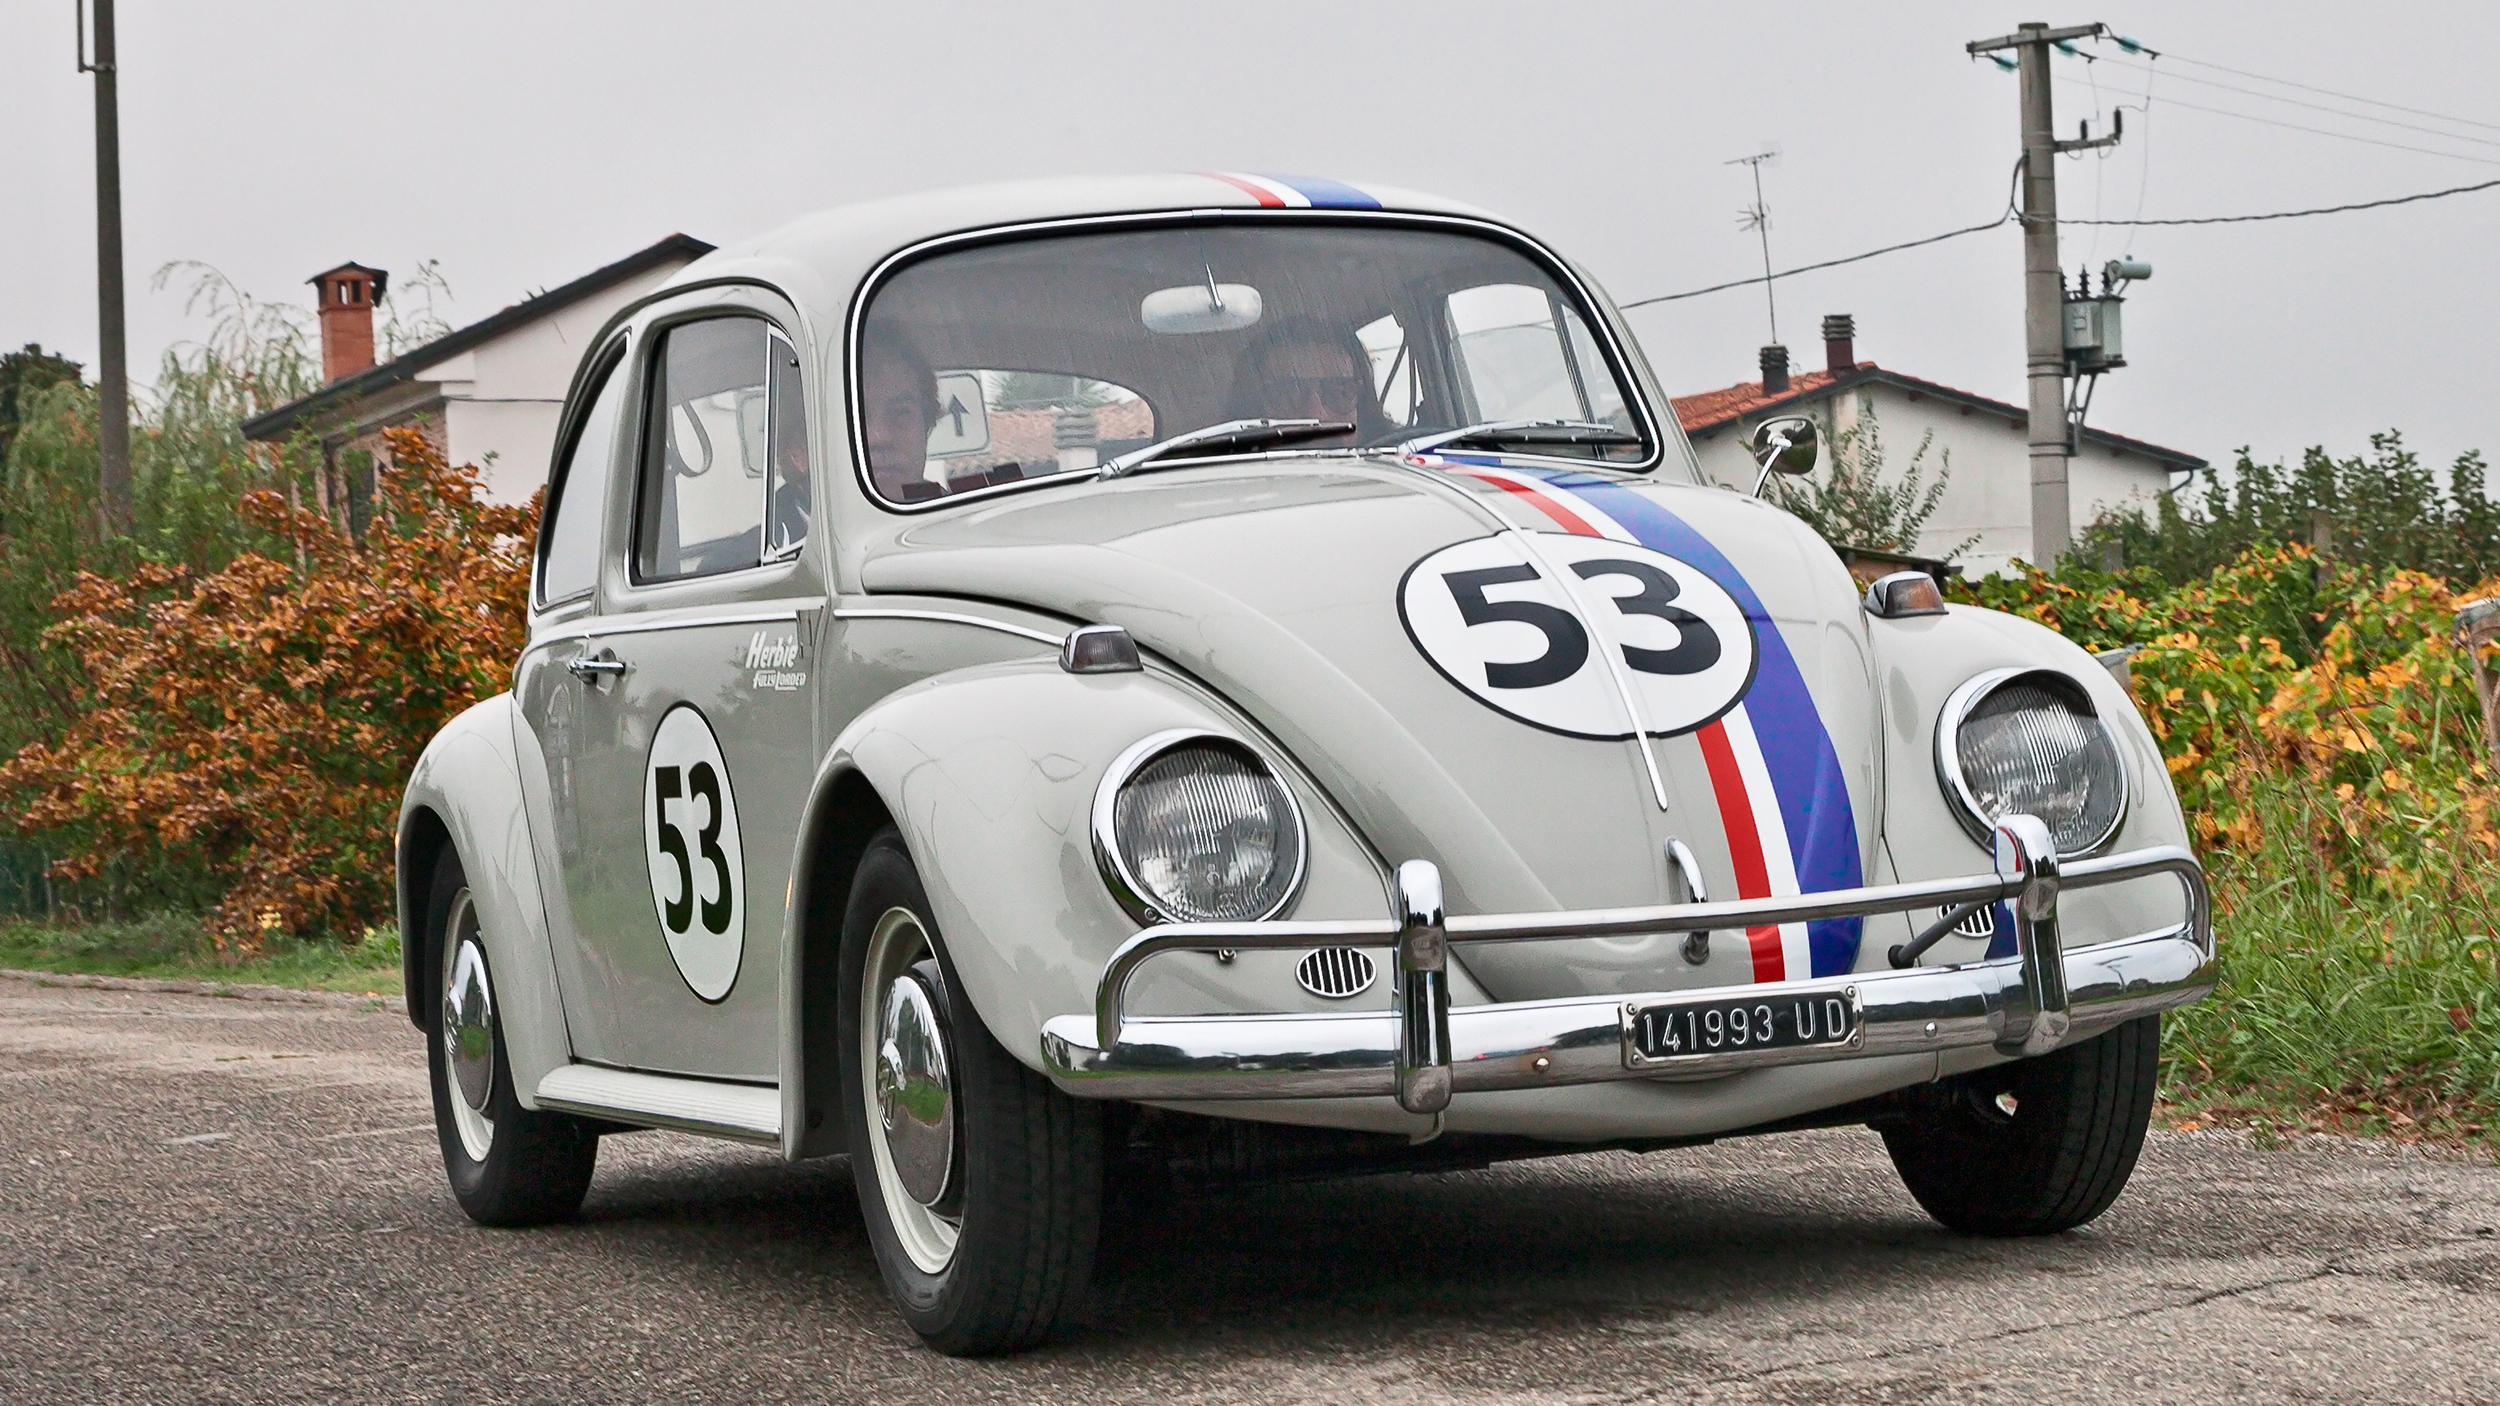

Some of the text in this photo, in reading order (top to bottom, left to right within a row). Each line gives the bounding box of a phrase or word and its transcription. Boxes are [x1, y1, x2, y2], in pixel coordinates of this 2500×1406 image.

[745, 630, 799, 669] Herbie
[1441, 558, 1722, 690] 53
[655, 761, 733, 935] 53
[1644, 999, 1847, 1053] 141993 UD
